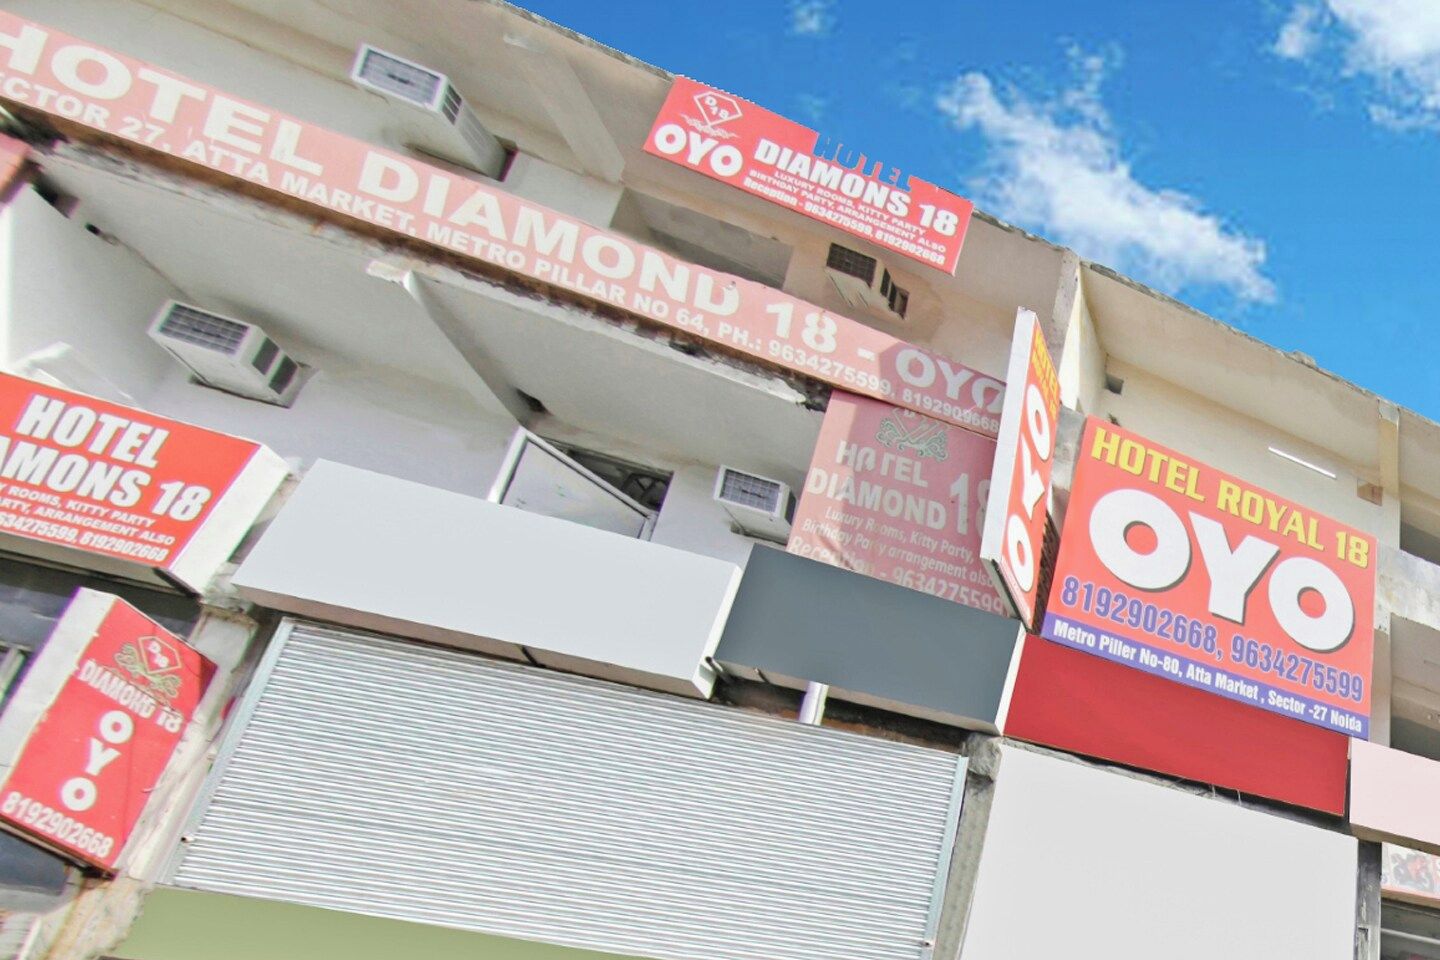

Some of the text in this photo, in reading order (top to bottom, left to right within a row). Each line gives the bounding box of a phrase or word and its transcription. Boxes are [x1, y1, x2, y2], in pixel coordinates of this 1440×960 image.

[653, 122, 744, 177] OYO
[753, 137, 960, 237] DIAMONS 18
[121, 115, 171, 151] 27,
[181, 138, 270, 185] ATTA
[279, 171, 417, 237] MARKET,
[426, 219, 527, 269] METRO
[533, 259, 627, 302] PILLAR
[633, 293, 669, 319] NO
[748, 169, 800, 194] BIRTHDAY
[836, 203, 917, 240] ARRANGEMENT
[917, 237, 947, 254] ALSO
[774, 170, 816, 192] LUXURY
[857, 203, 890, 221] KITTY
[891, 217, 926, 236] PARTY
[358, 150, 740, 316] DIAMOND
[765, 301, 838, 355] 18
[15, 394, 171, 470] HOTEL
[33, 505, 140, 538] ARRANGEMENT
[139, 530, 177, 546] ALSO
[65, 499, 111, 517] KITTY
[110, 509, 157, 529] PARTY
[152, 480, 213, 522] 18
[806, 467, 947, 530] DIAMOND
[865, 516, 908, 543] Roms,
[1091, 427, 1369, 569] HOTEL ROYAL 18
[1088, 488, 1356, 653] OYO
[1053, 619, 1096, 648] Metro
[1099, 631, 1137, 661] Piller
[1139, 646, 1183, 678] No-80,
[1186, 661, 1212, 685] Atta
[1268, 690, 1307, 715] Sector
[1330, 708, 1362, 733] Noida
[1059, 574, 1364, 703] 8192902668, 9634275599
[77, 658, 184, 734] DIAMOND 18
